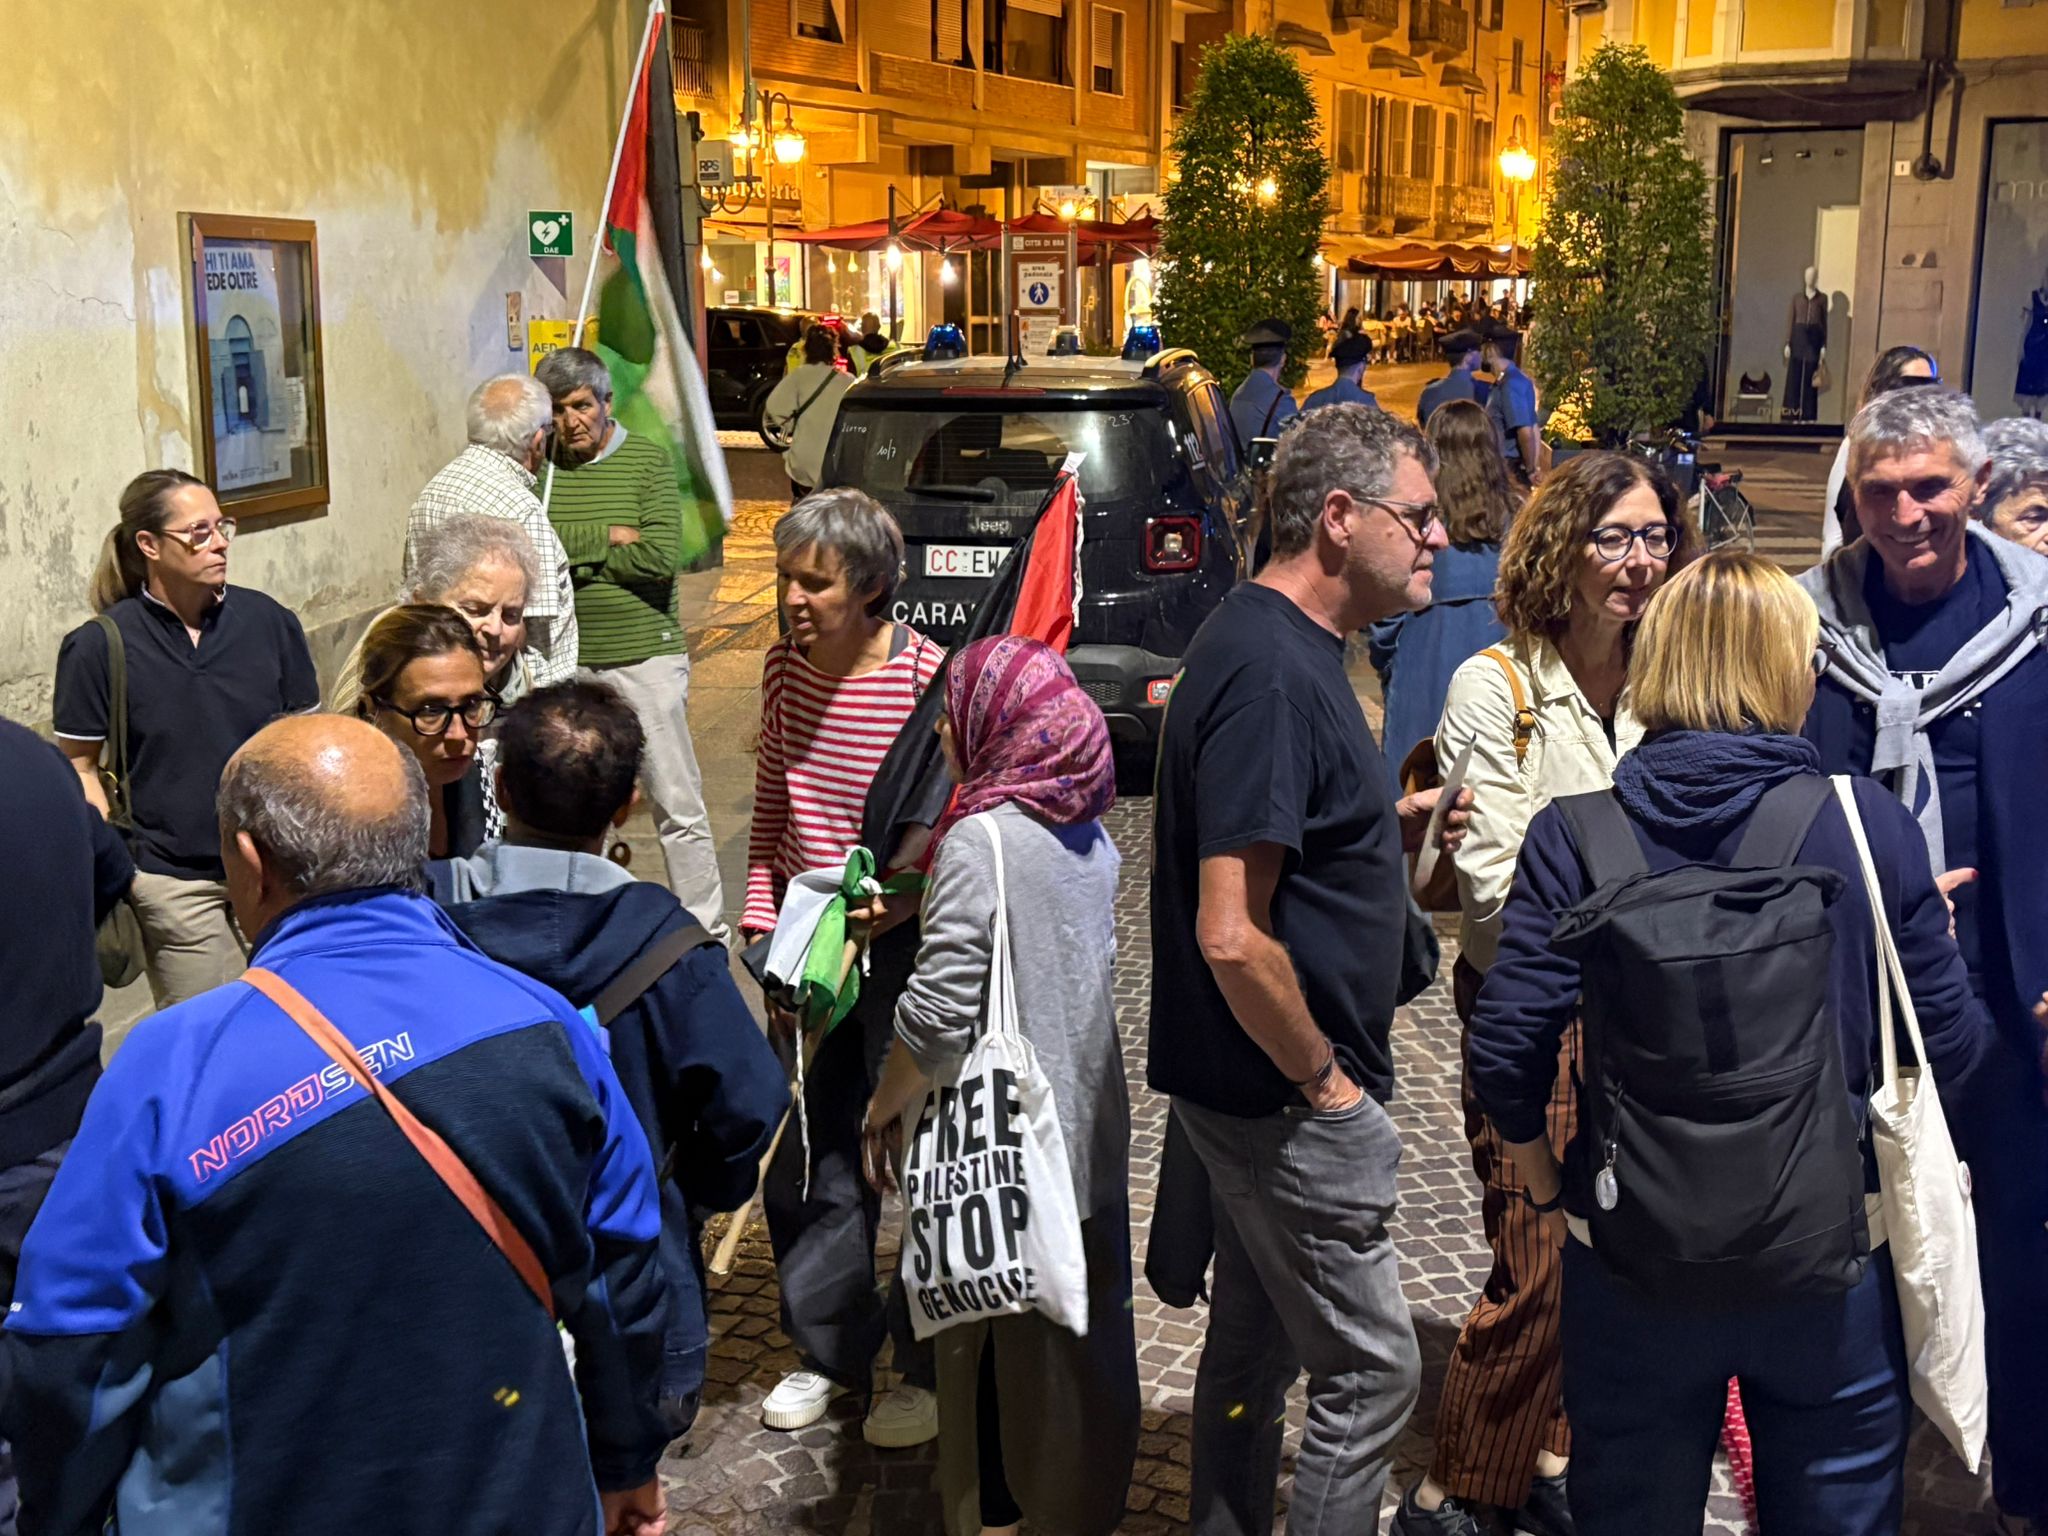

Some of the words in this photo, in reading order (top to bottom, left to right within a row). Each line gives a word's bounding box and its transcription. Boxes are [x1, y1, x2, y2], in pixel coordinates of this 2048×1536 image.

[700, 160, 719, 171] RPS
[218, 252, 229, 270] TI
[231, 251, 255, 270] AMA
[228, 271, 258, 289] OLTRE
[533, 342, 558, 353] AED
[970, 518, 1012, 535] Jeep
[931, 549, 958, 573] CC
[891, 601, 976, 625] CARA
[188, 1032, 415, 1183] NORDSEN
[909, 1068, 1023, 1170] FREE
[907, 1149, 1027, 1207] PALESTINE
[911, 1185, 1029, 1283] STOP
